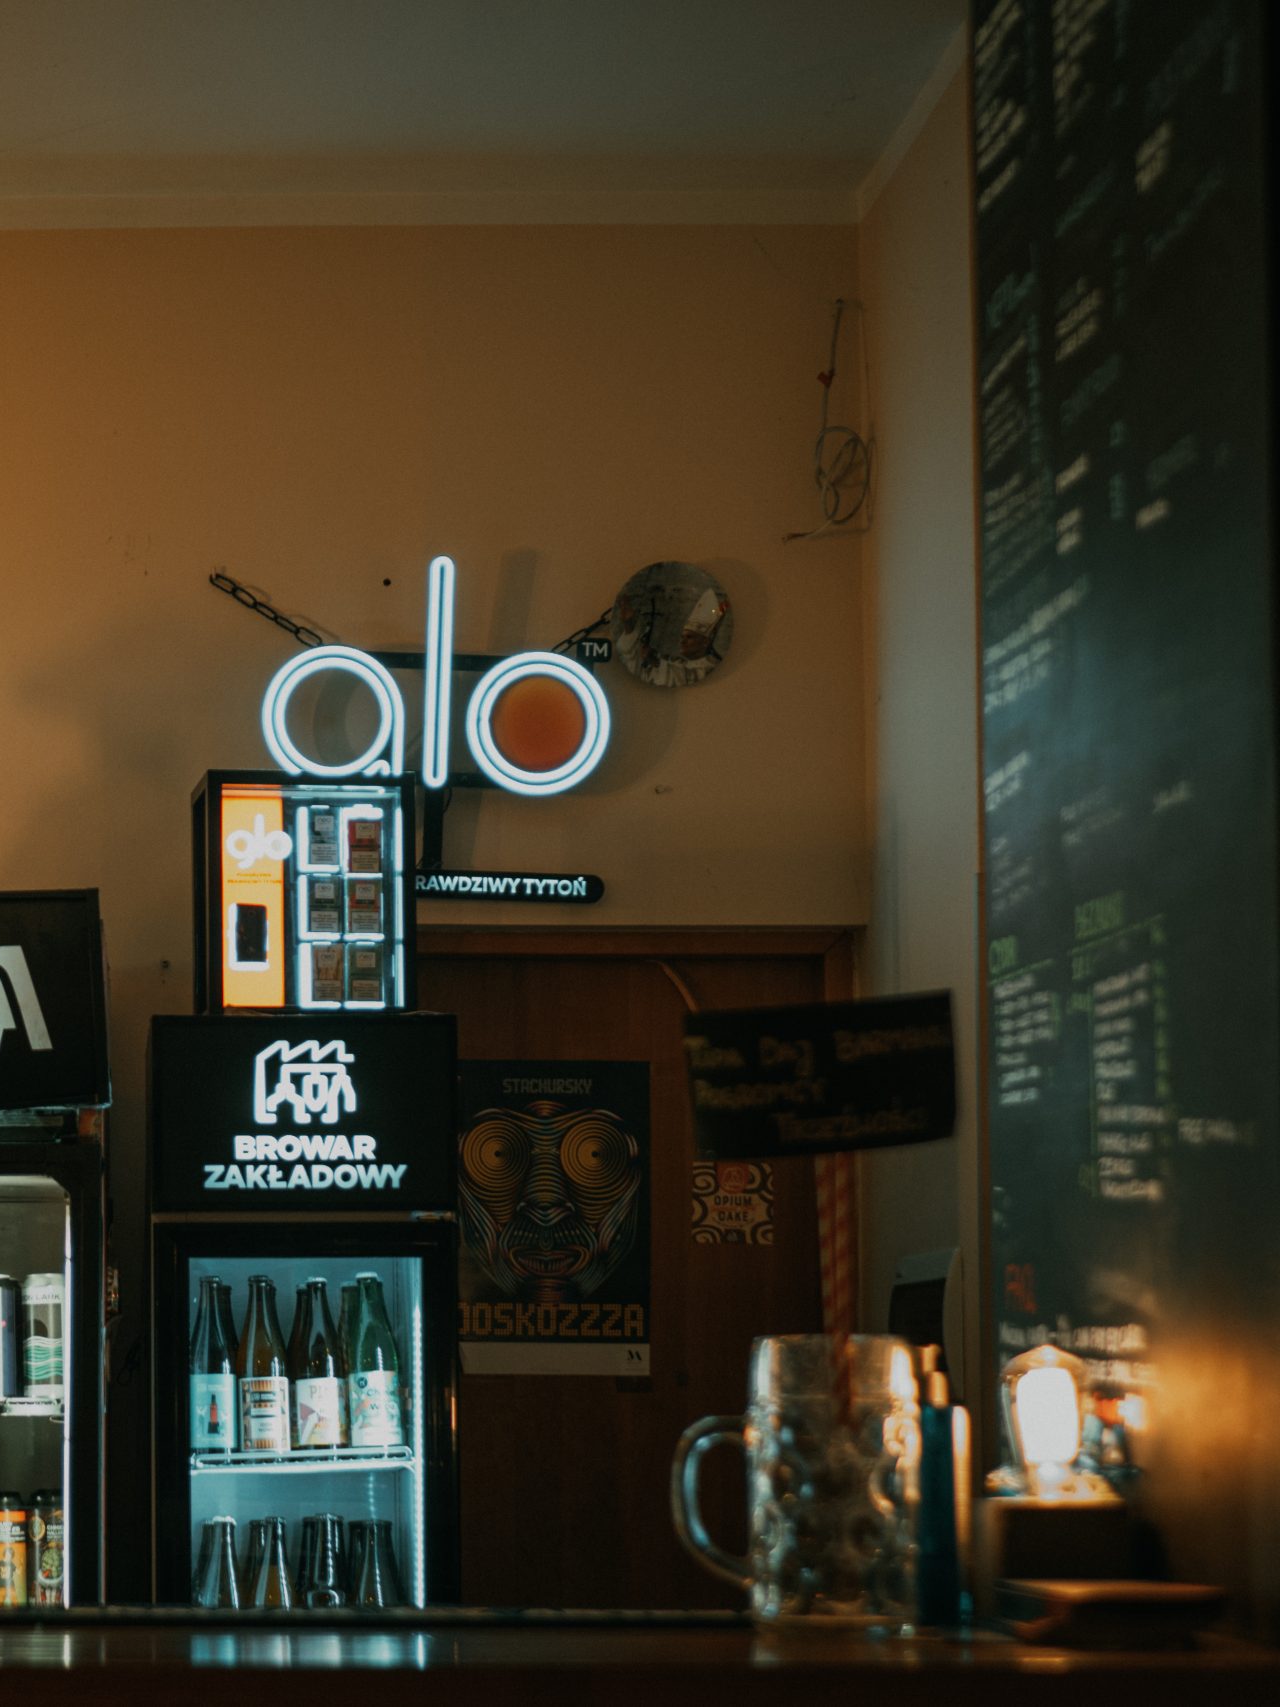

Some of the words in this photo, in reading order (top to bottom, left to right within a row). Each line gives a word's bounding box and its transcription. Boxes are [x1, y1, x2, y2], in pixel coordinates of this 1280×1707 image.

[582, 642, 608, 657] TM
[226, 813, 293, 869] glo
[416, 875, 521, 894] RAWDZIWY
[522, 876, 587, 896] TYTOŃ
[502, 1078, 592, 1095] STACHURSKY
[234, 1135, 376, 1161] BROWAR
[203, 1164, 408, 1189] ZAKŁADOWY
[714, 1195, 752, 1205] OPIUM
[718, 1211, 749, 1221] CAKE
